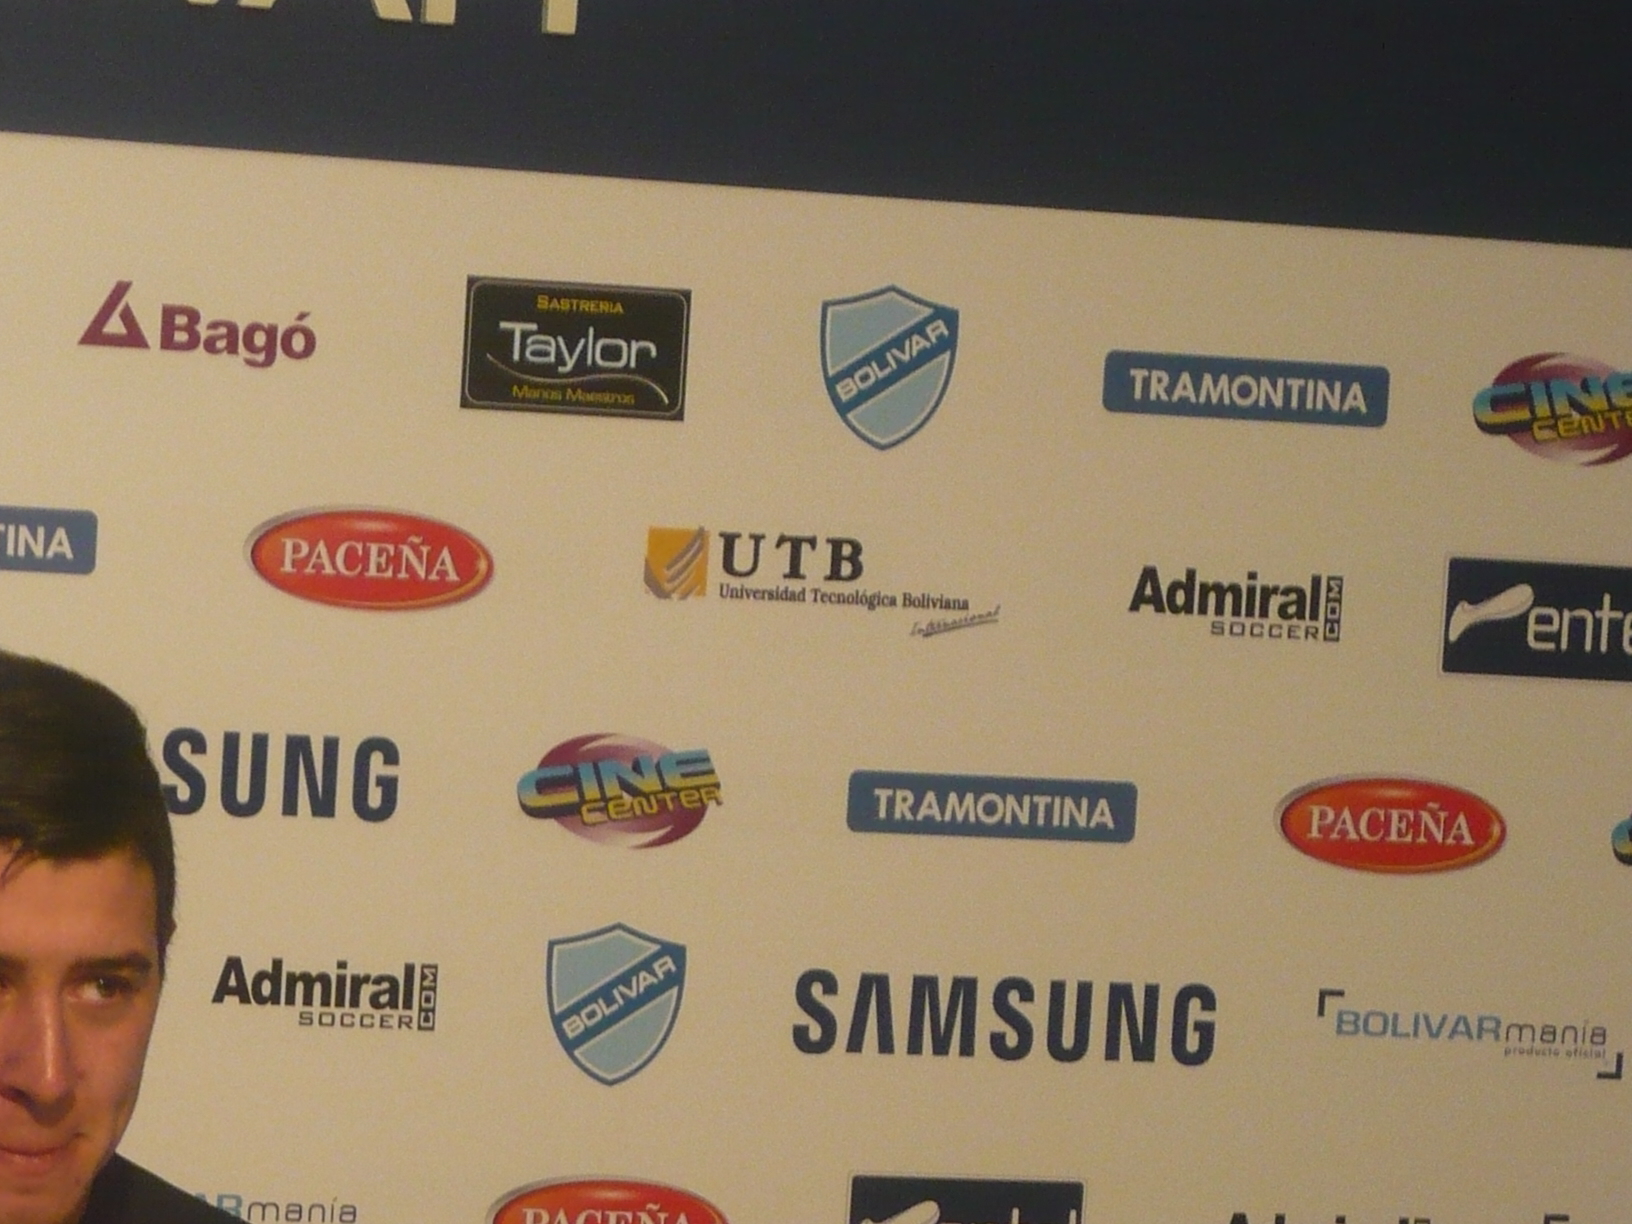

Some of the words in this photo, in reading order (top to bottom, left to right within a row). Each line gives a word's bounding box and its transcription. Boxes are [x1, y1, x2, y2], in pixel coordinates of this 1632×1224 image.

[159, 303, 317, 368] Bagó
[499, 320, 657, 373] Taylor
[834, 317, 949, 402] BOLIVAR
[1129, 367, 1369, 414] TRAMONTINA
[1532, 410, 1632, 443] CENT
[279, 530, 460, 583] PACEÑA
[718, 531, 864, 581] UTB
[719, 583, 806, 602] Universidad
[811, 588, 897, 611] Tecnológica
[902, 591, 970, 611] Boliviana
[1128, 565, 1321, 622] Admiral
[1210, 620, 1320, 642] SOCCER
[517, 747, 723, 818] CINE
[872, 787, 1116, 831] TRAMONTINA
[1306, 802, 1476, 847] PACEÑA
[212, 955, 416, 1012] Admiral
[562, 954, 678, 1041] BOLIVAR
[298, 1011, 413, 1031] SOCCER
[792, 968, 1218, 1066] SAMSUNG
